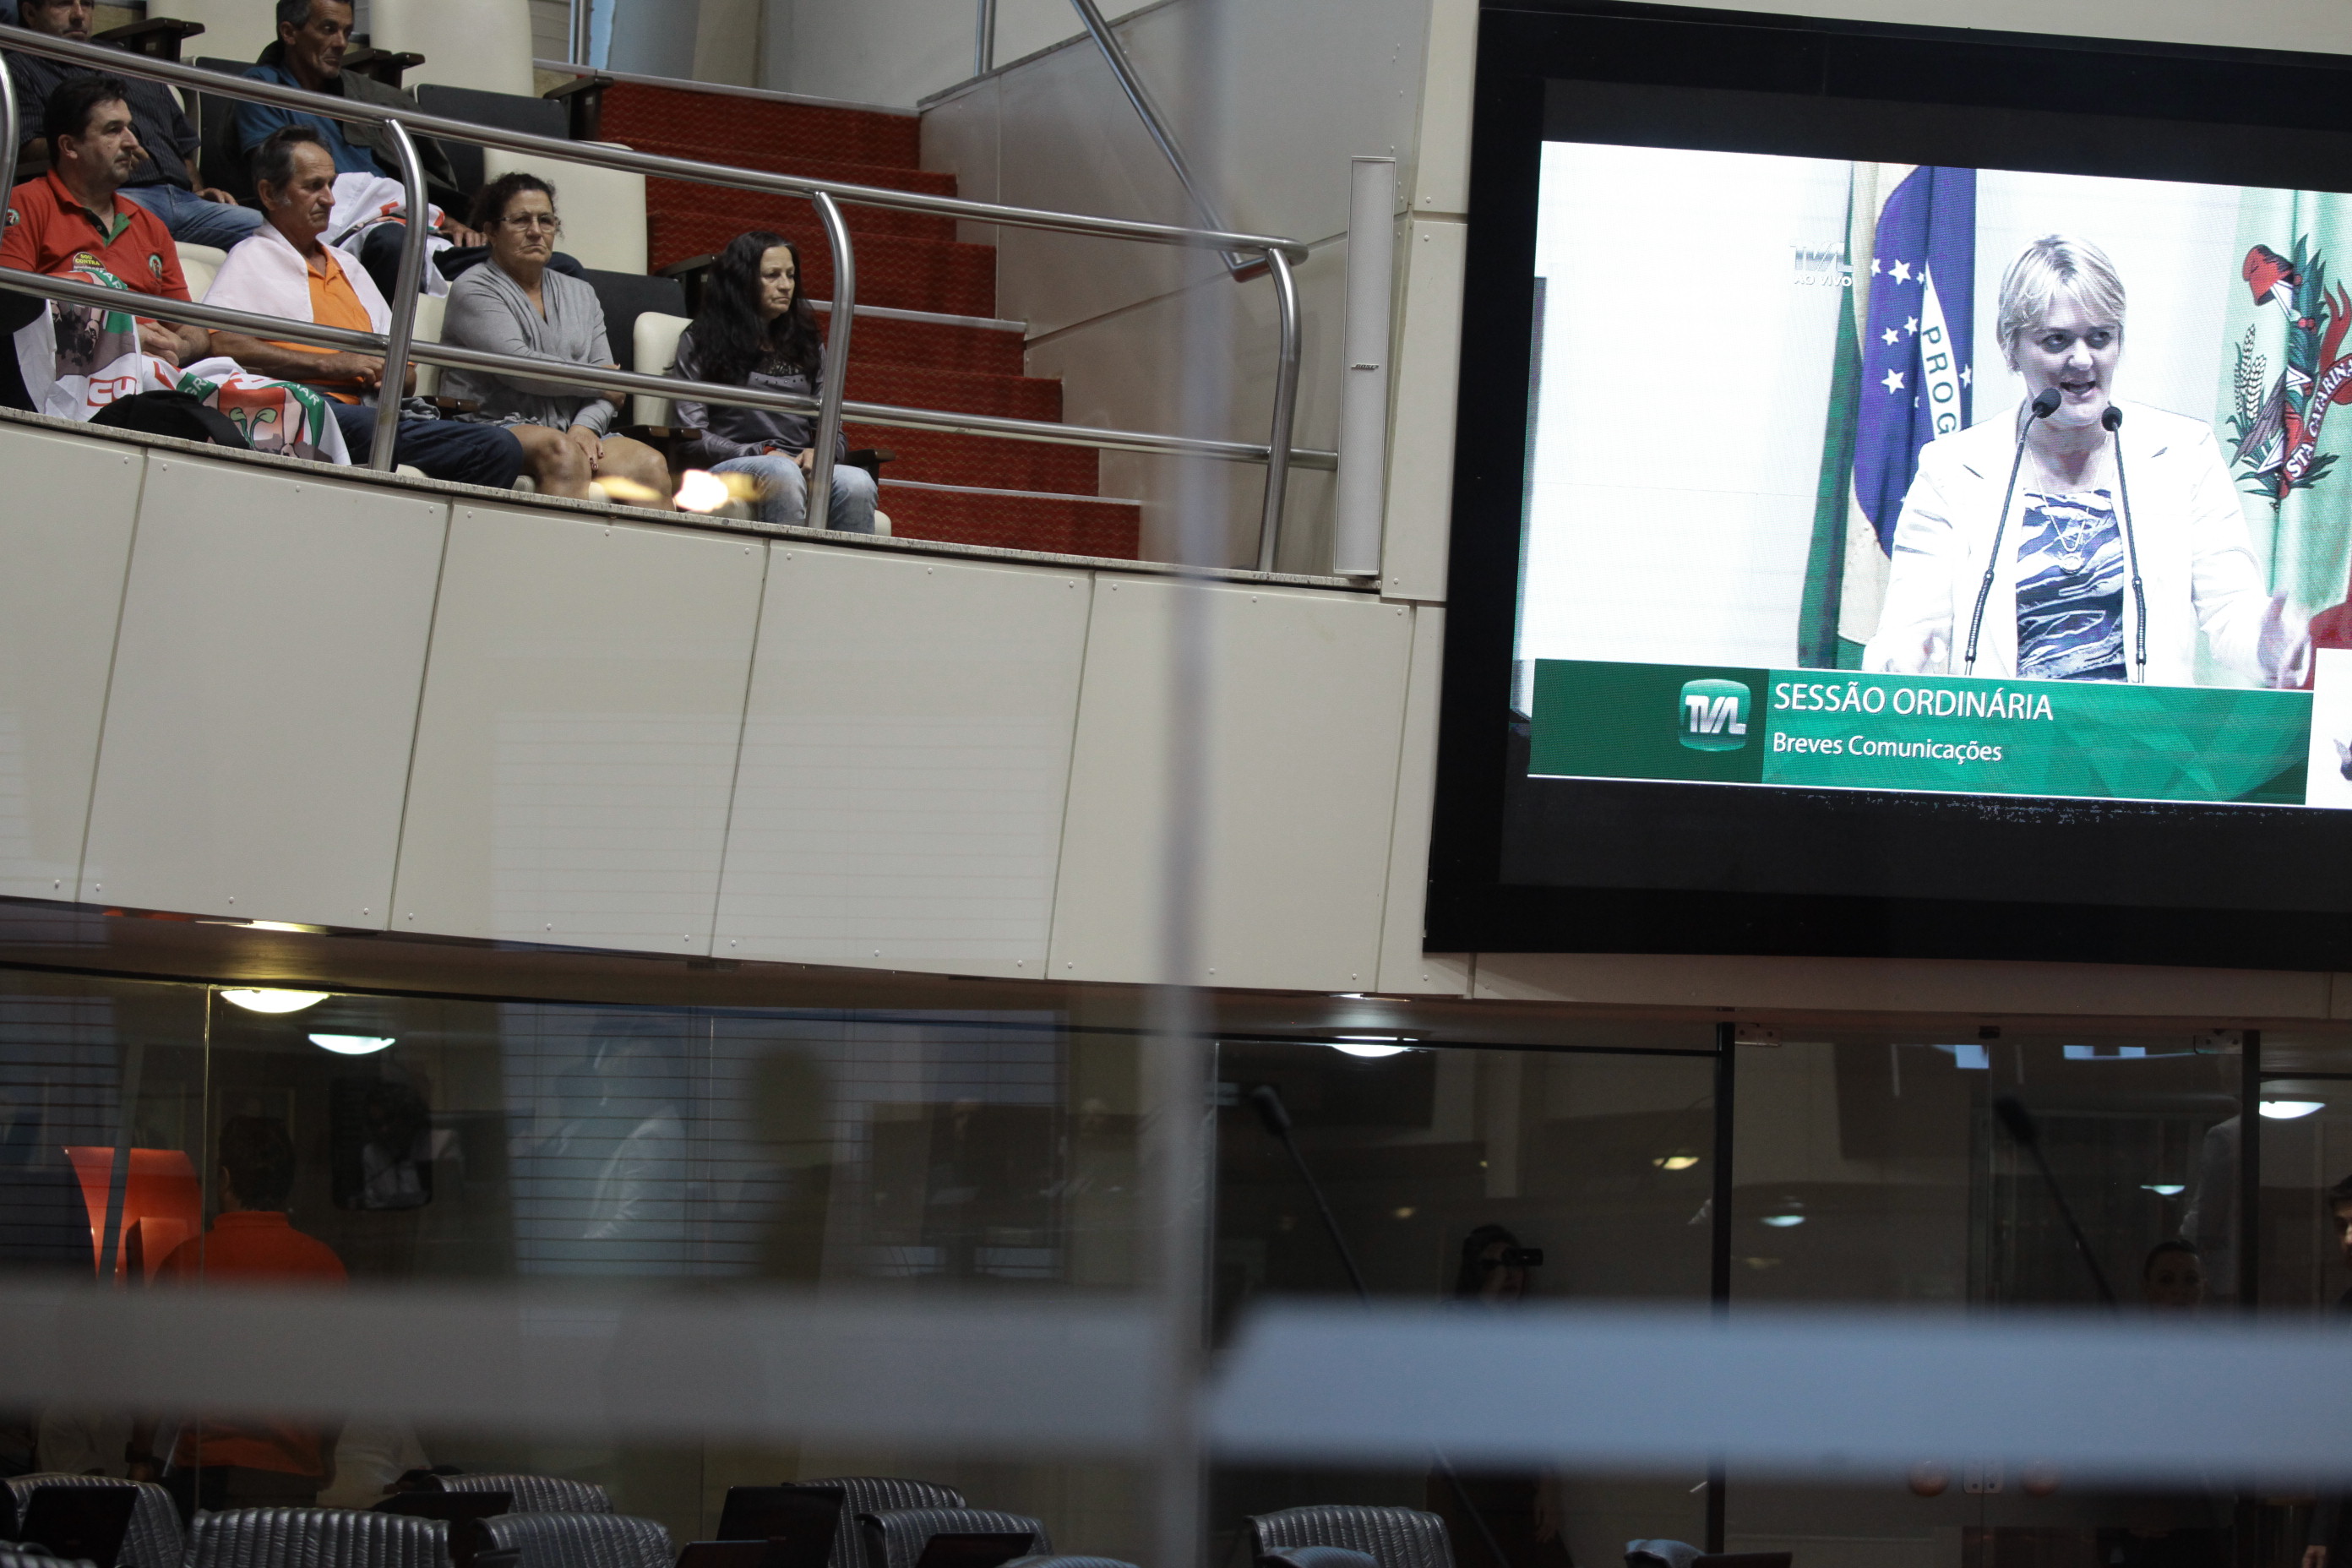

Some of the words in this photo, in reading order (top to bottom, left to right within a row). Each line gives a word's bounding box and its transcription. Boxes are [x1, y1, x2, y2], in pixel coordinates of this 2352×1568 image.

[74, 258, 101, 266] CONTRA
[1819, 275, 1854, 287] VIVO
[1774, 681, 1886, 714] SESSÃO
[1892, 687, 2055, 721] ORDINÁRIA
[1773, 732, 1843, 756] Breves
[1848, 735, 2003, 765] Comunicações
